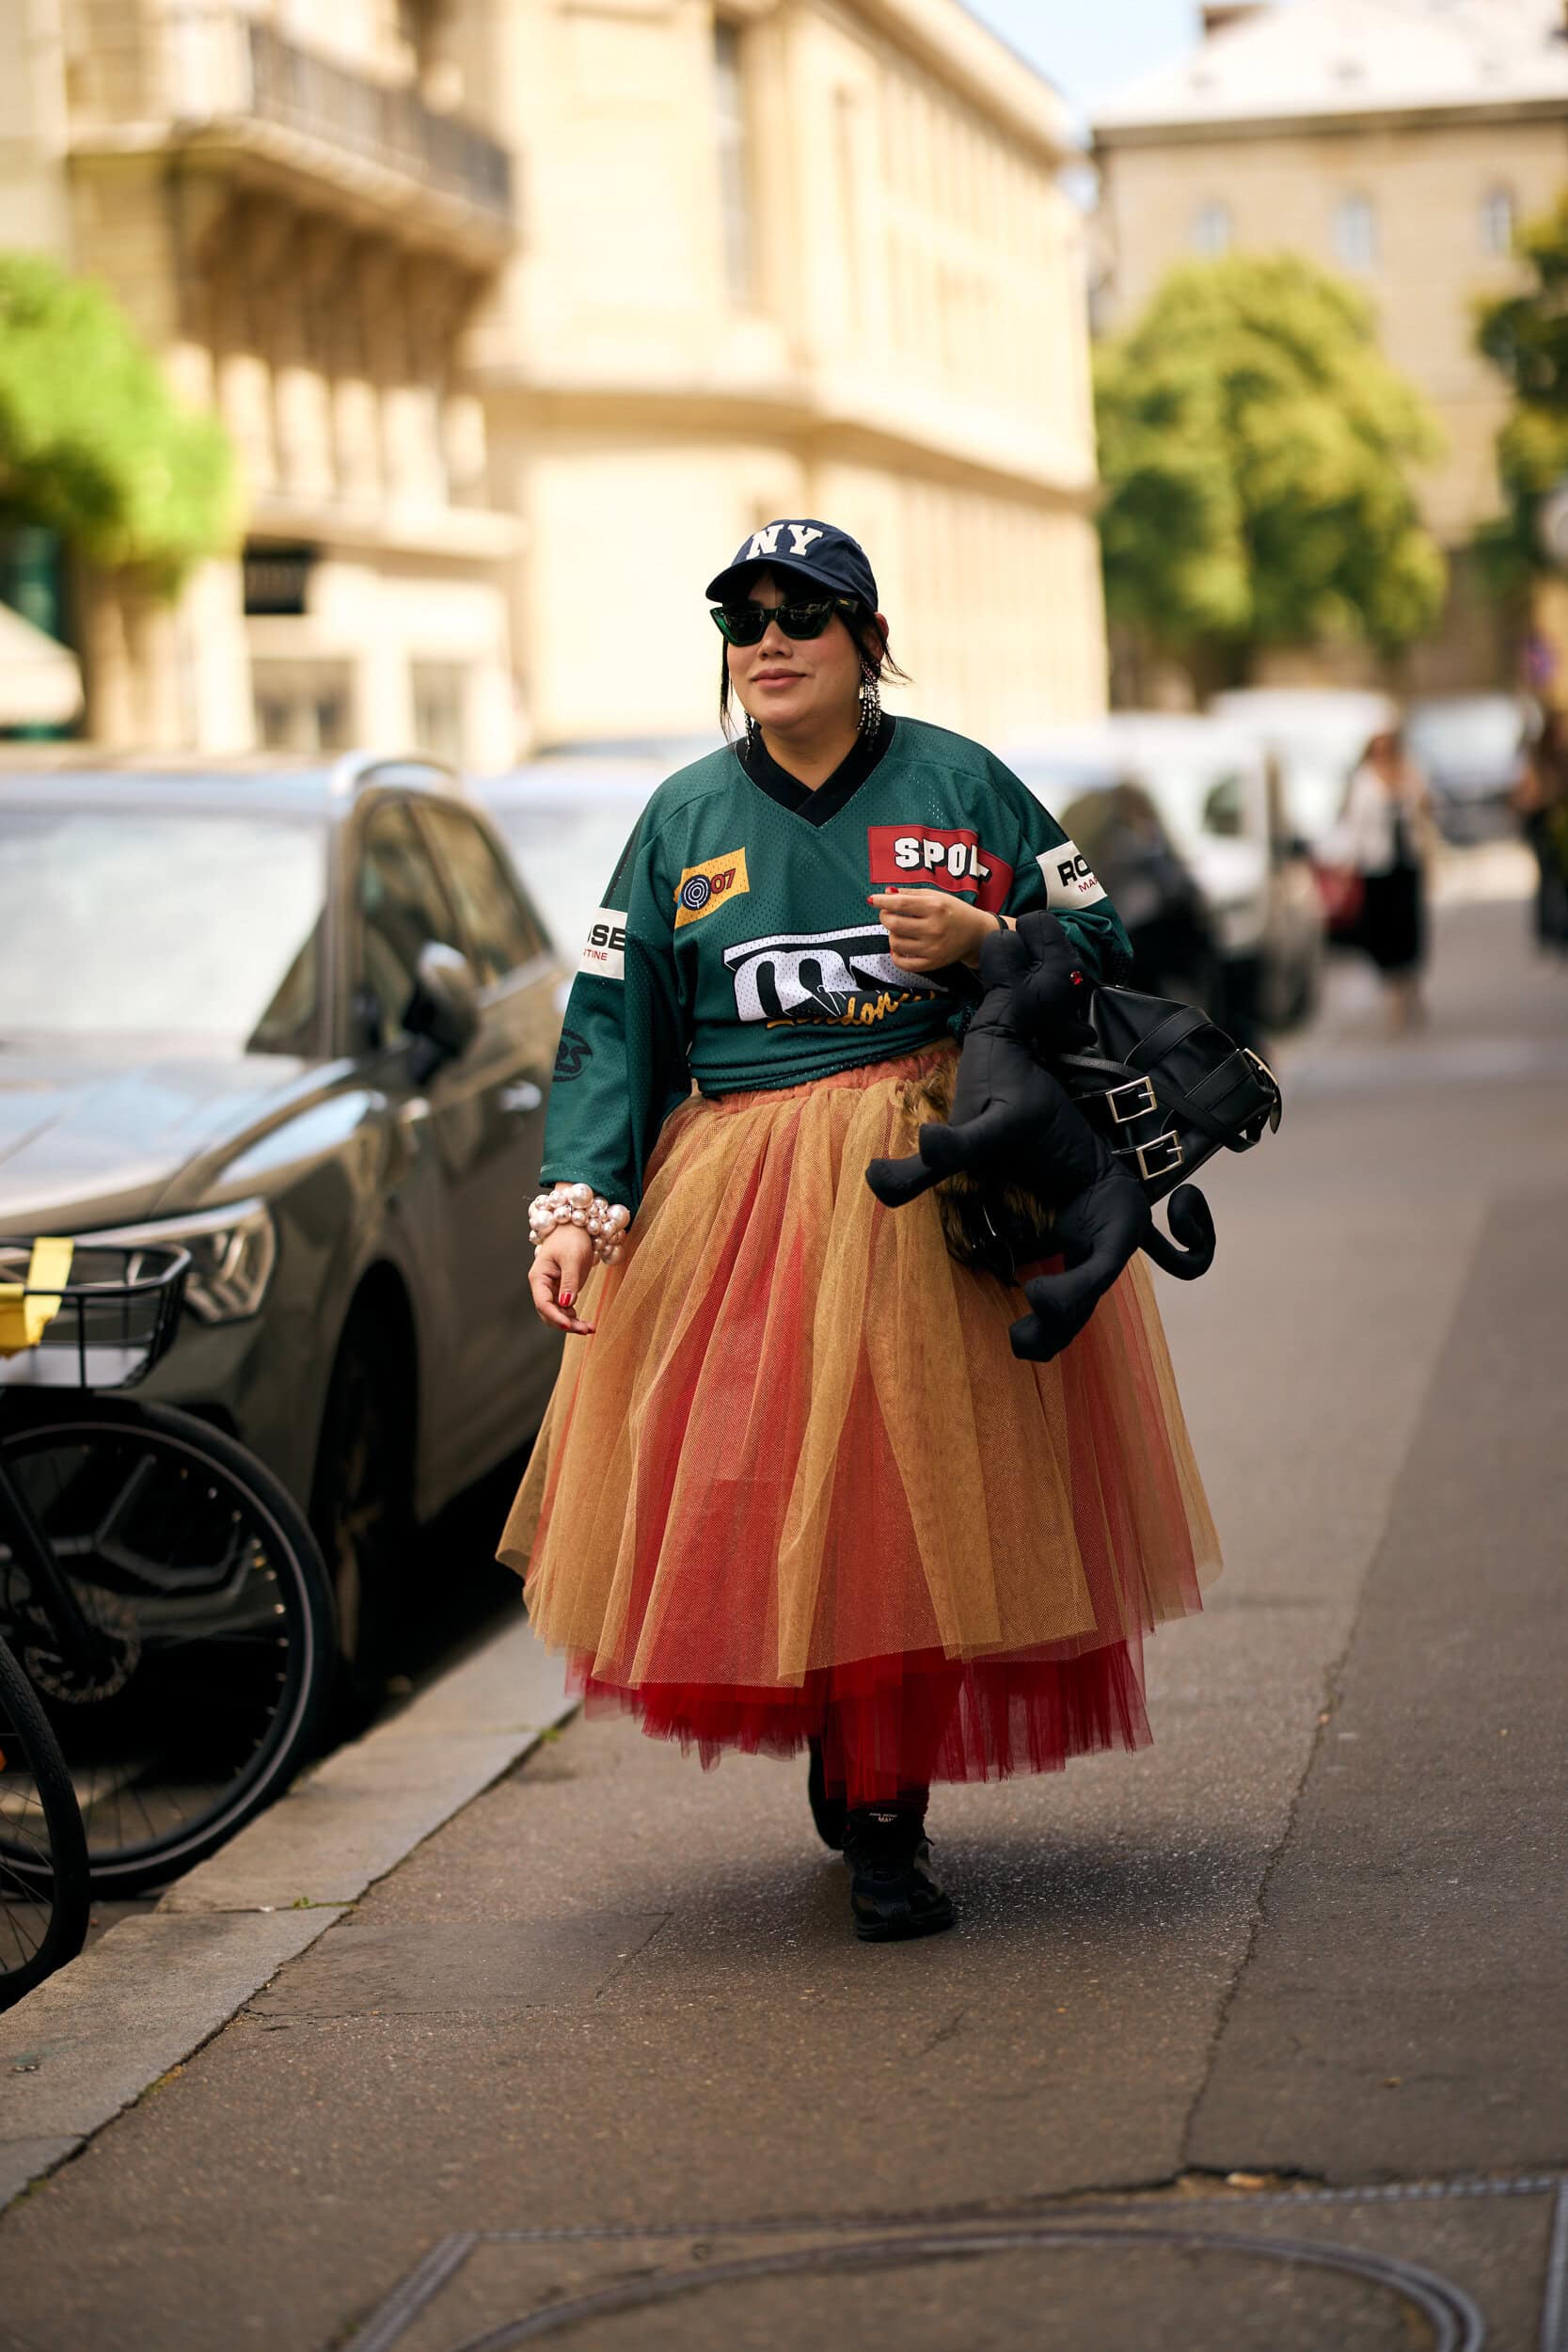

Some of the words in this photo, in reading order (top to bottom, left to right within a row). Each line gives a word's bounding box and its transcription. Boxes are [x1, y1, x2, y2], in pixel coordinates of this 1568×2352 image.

[746, 524, 823, 560] NY
[587, 924, 626, 951] SE
[583, 948, 608, 961] TINE
